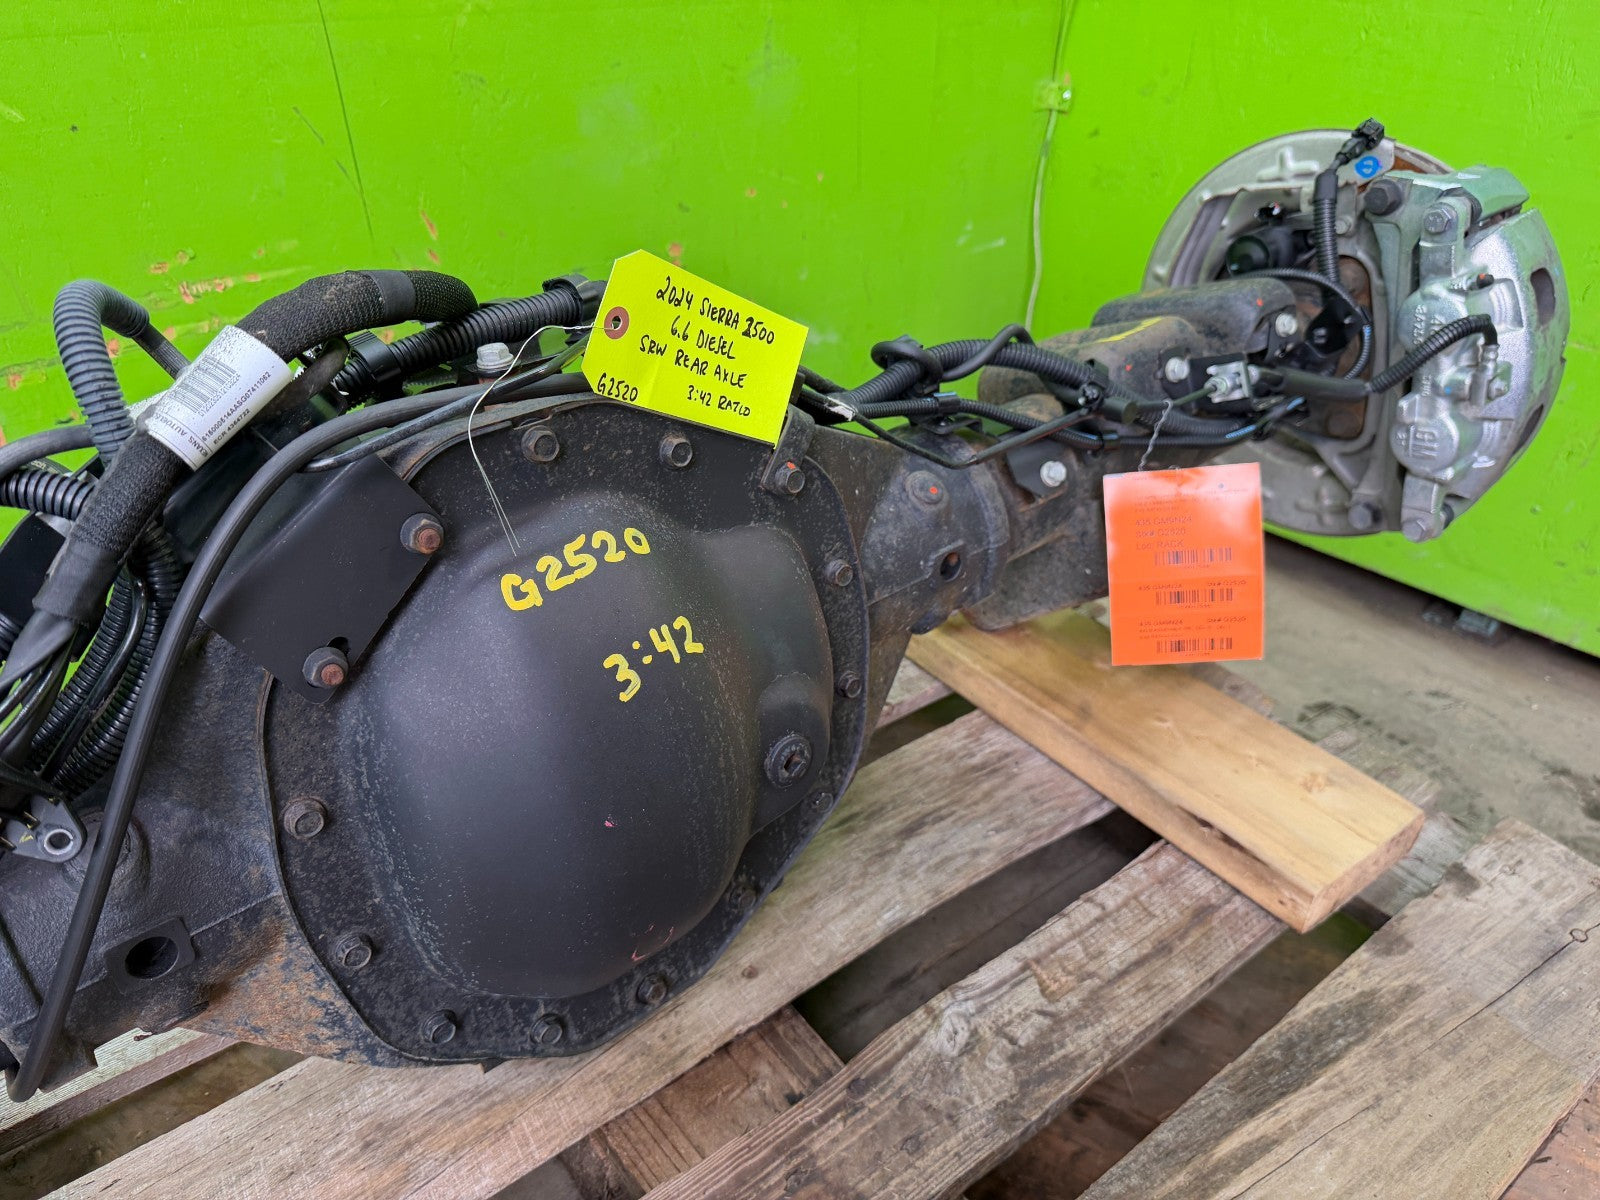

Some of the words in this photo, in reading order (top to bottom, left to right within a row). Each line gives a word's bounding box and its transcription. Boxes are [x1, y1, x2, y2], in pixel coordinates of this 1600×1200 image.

[656, 275, 694, 310] 2024
[699, 297, 740, 330] SIERRA
[639, 335, 668, 357] SRW
[674, 351, 709, 376] REAR
[713, 364, 748, 389] AXLE
[670, 315, 689, 342] 6.6
[696, 330, 736, 360] DIESEL
[596, 372, 639, 403] G2520
[687, 384, 711, 407] 3:42
[717, 395, 751, 417] RATIO
[213, 430, 227, 445] ECR
[500, 527, 651, 611] G2520
[602, 615, 704, 703] 3:42
